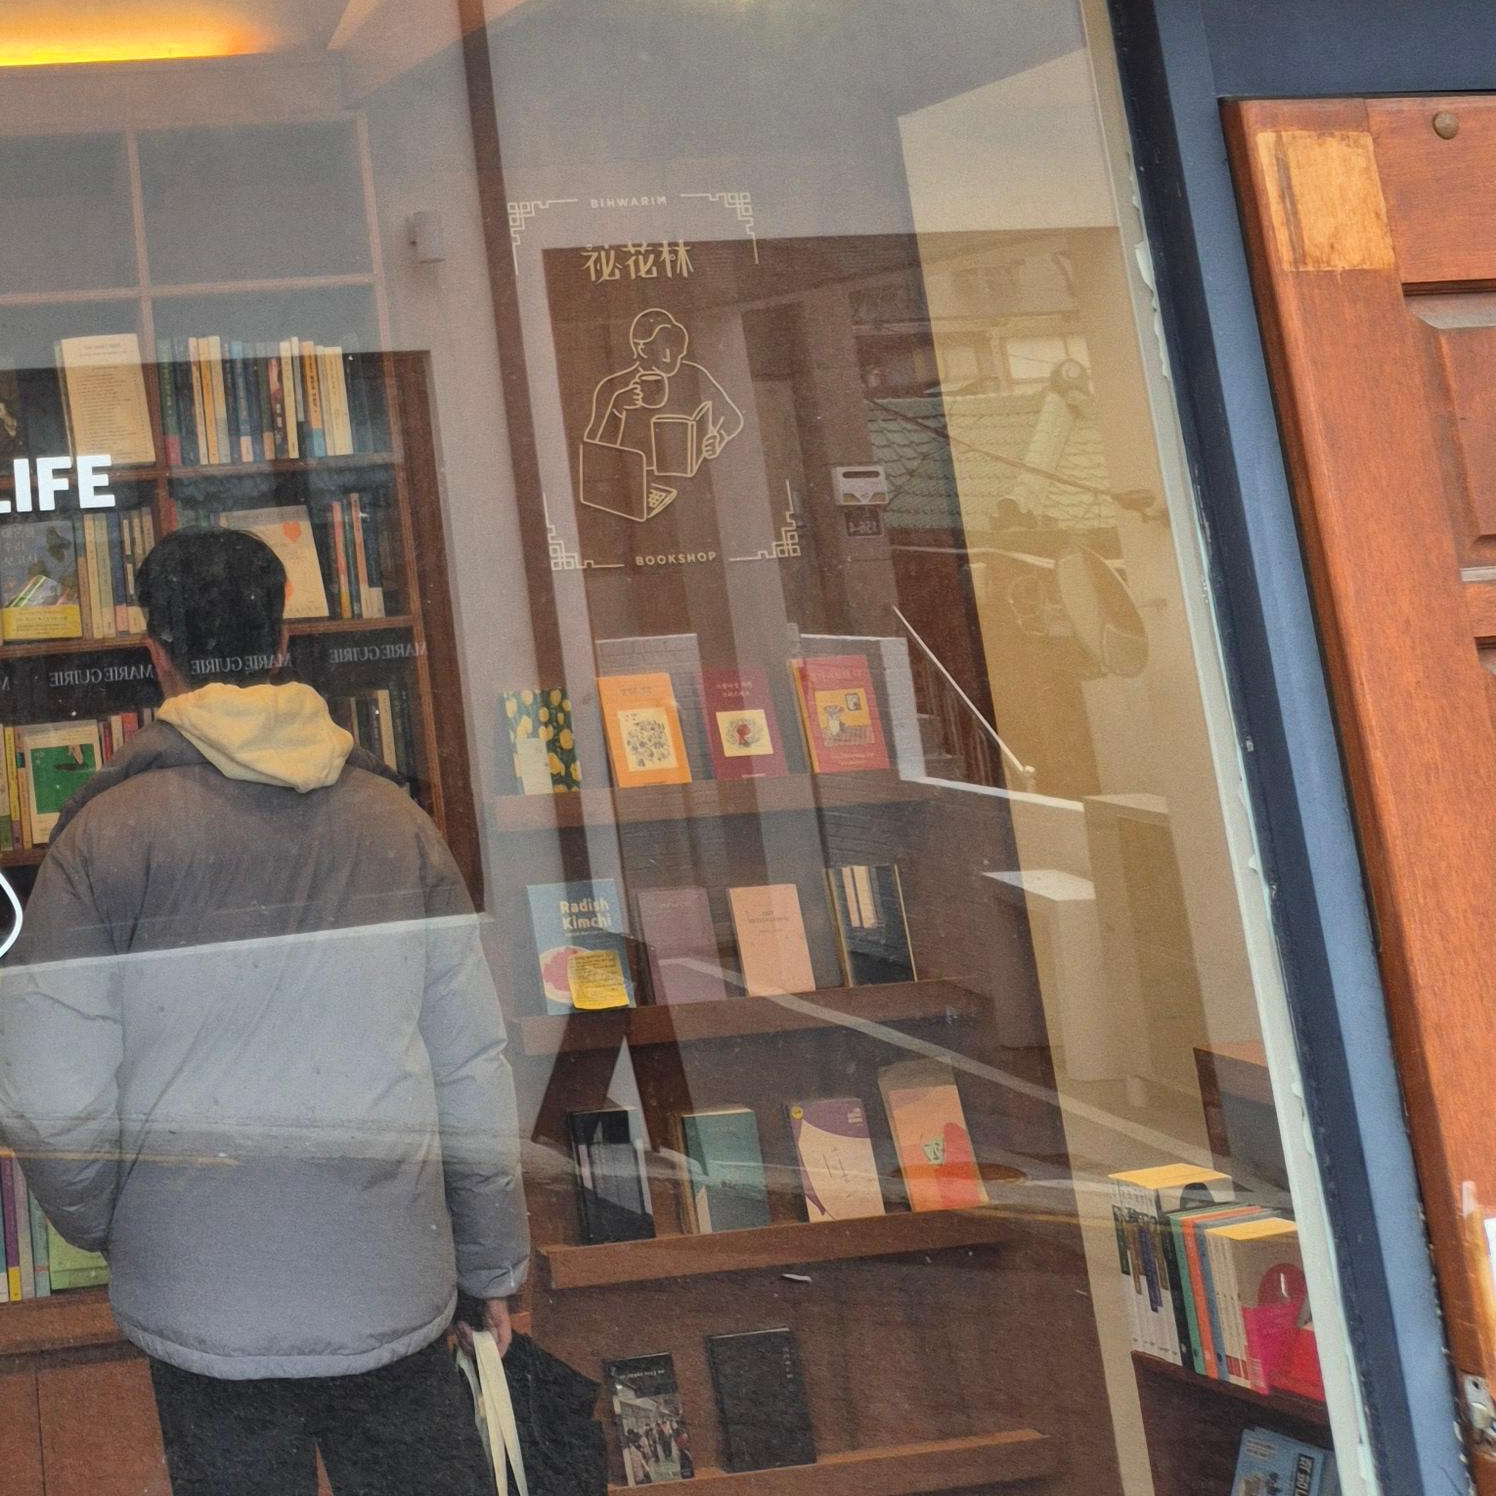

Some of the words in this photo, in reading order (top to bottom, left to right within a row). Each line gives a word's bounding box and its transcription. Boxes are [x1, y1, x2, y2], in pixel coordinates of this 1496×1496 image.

[590, 195, 668, 209] BIHWARIM
[635, 551, 717, 566] BOOKSHOP
[559, 898, 610, 914] Radish
[562, 912, 613, 930] Kimchi
